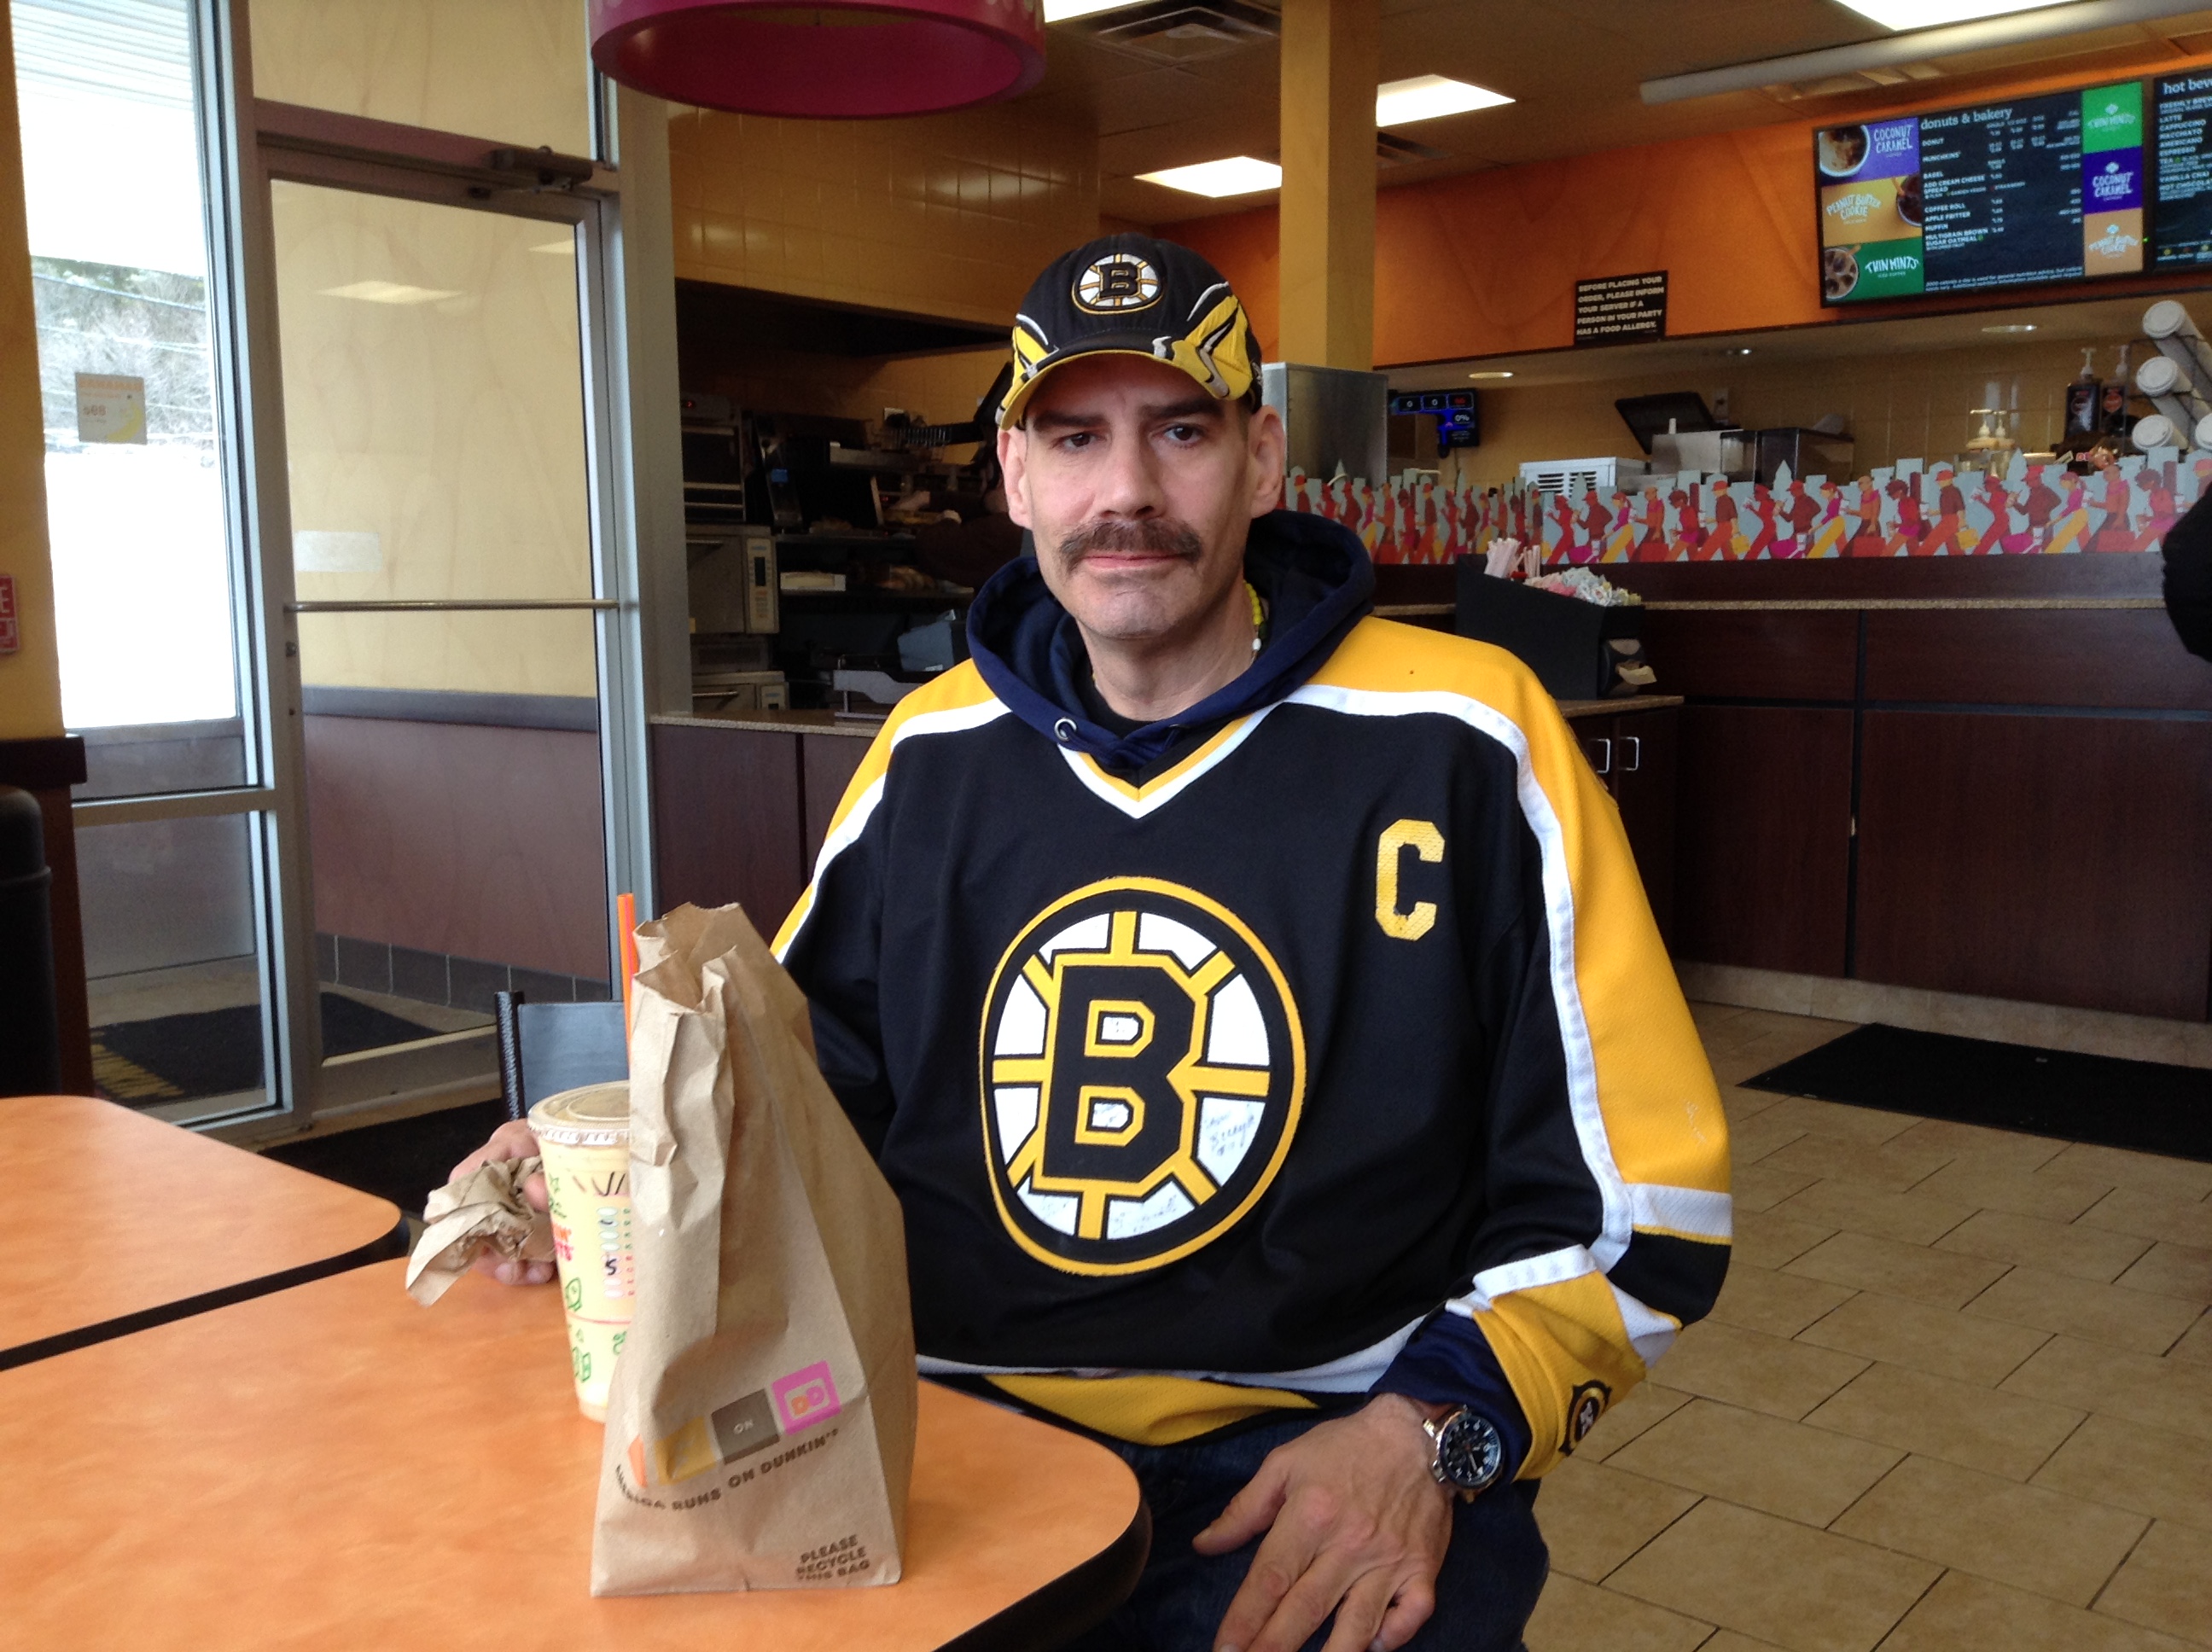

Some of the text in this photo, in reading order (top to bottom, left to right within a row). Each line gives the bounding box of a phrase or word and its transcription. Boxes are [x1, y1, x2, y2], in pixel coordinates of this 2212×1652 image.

[2163, 82, 2186, 95] hot
[1921, 108, 2012, 130] donuts & bakery
[1874, 125, 1912, 142] COCONUT
[1877, 137, 1912, 153] CARAMEL
[2093, 172, 2133, 188] COCONUT
[2094, 183, 2133, 197] CARAMEL
[1826, 195, 1855, 216] PEANUT
[1865, 256, 1919, 273] THIN MINTS
[1097, 263, 1142, 300] B
[1579, 276, 1662, 292] BEFORE PLACING YOUR
[1606, 290, 1634, 300] PLEASE
[1635, 287, 1664, 296] INFORM
[1599, 302, 1628, 311] SERVER
[1577, 316, 1606, 324] PERSON
[1638, 309, 1662, 317] PARTY
[1376, 818, 1445, 941] C
[1033, 954, 1207, 1195] B
[734, 1419, 754, 1434] ON
[672, 1487, 721, 1510] RUNS
[728, 1469, 754, 1487] ON
[800, 1534, 858, 1563] PLEASE
[796, 1546, 867, 1575] RECYCLE
[837, 1560, 870, 1577] BAG
